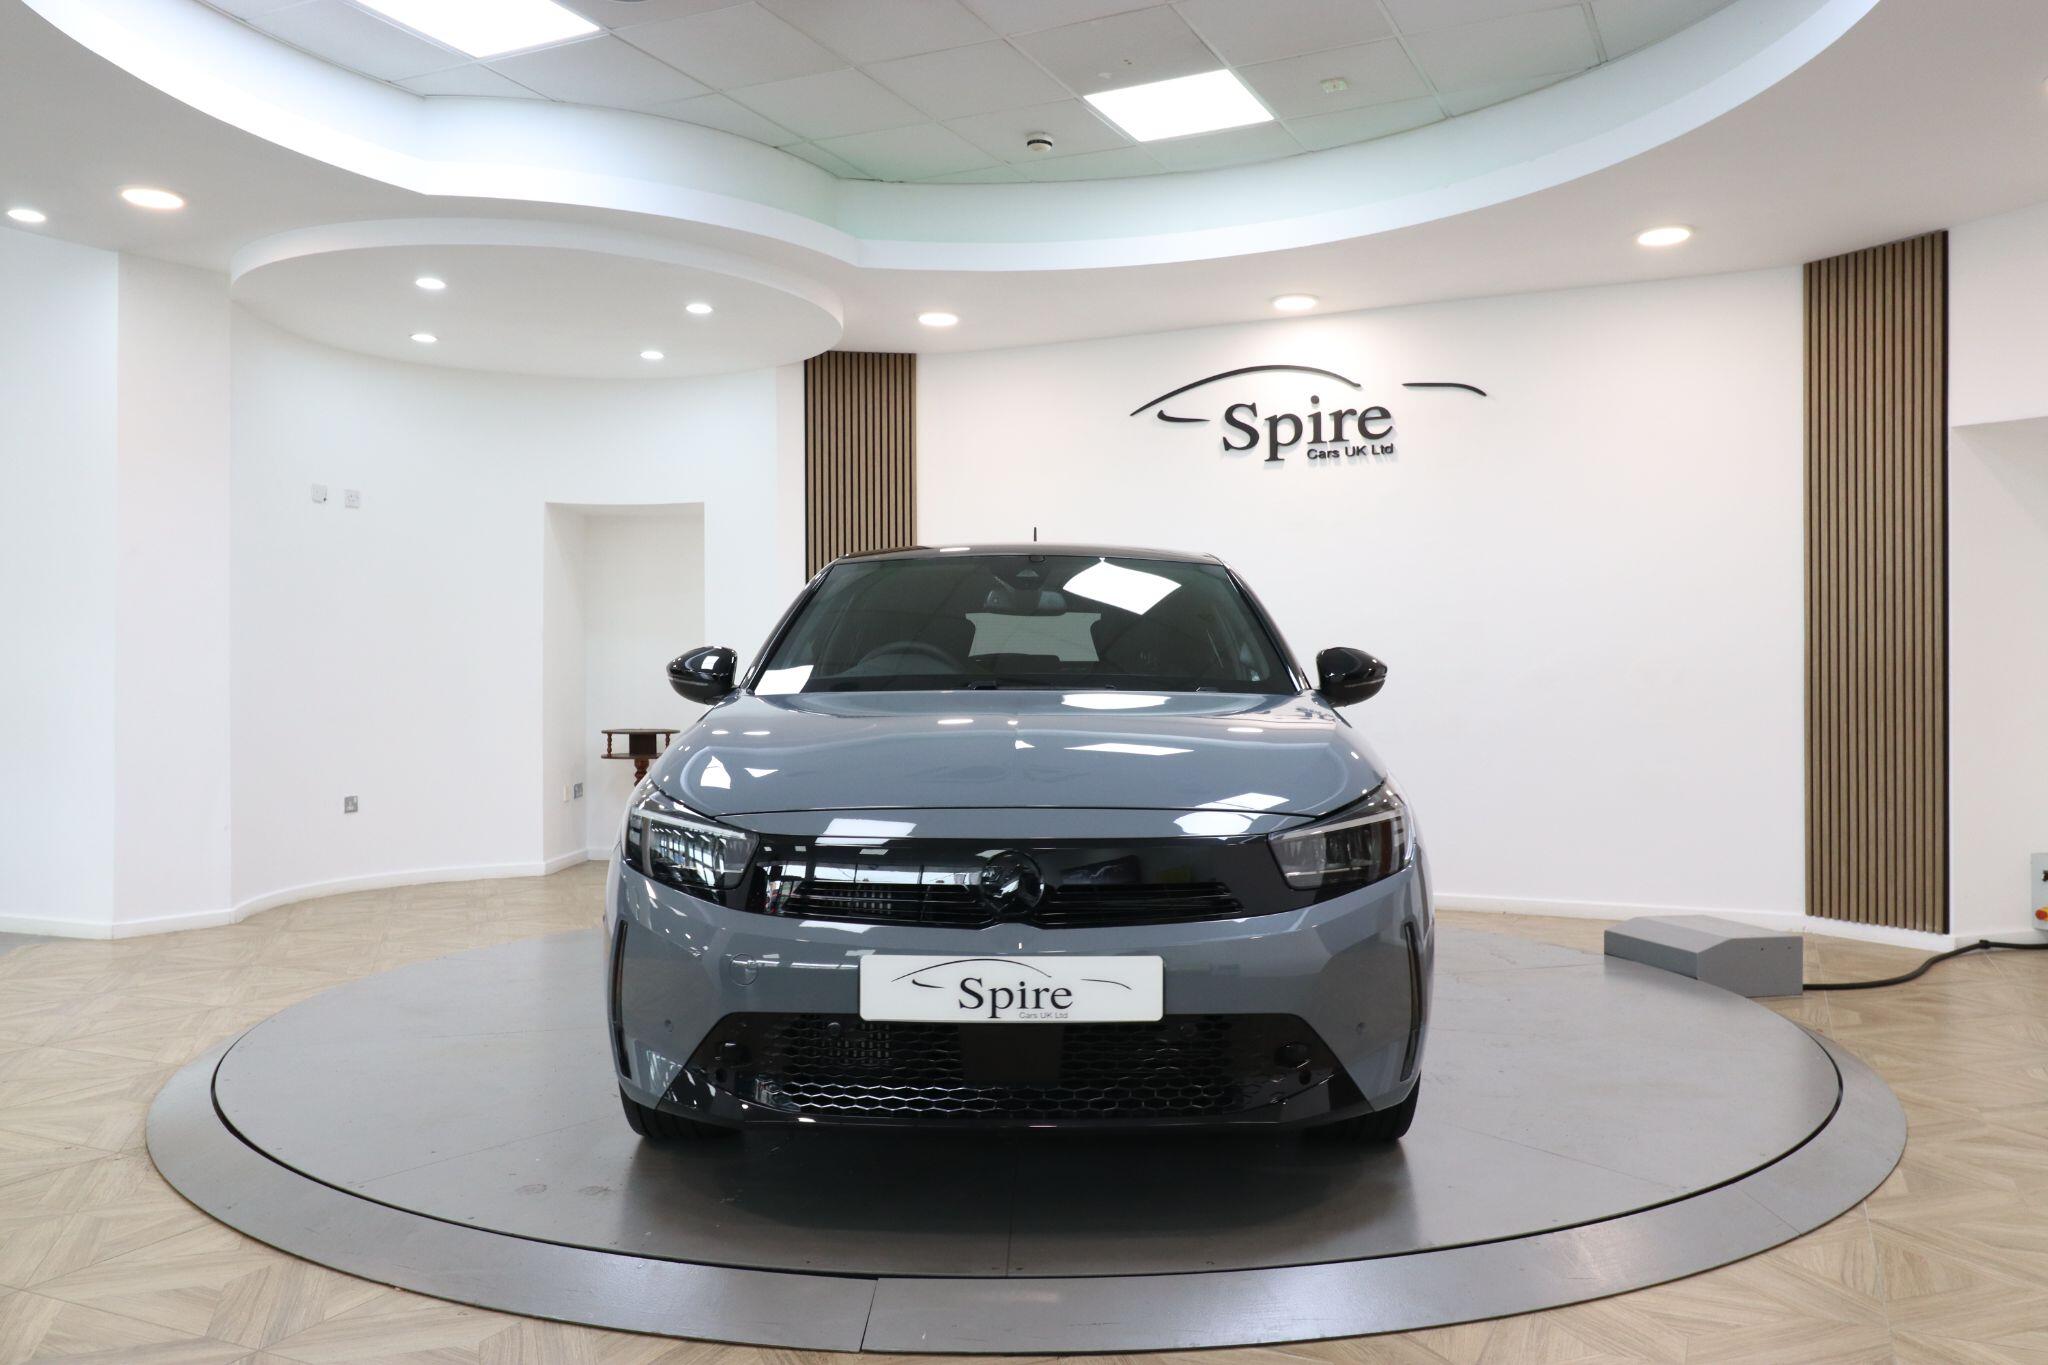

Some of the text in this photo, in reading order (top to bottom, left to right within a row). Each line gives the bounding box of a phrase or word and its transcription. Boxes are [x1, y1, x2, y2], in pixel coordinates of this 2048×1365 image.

[1222, 394, 1393, 462] Spire
[1306, 442, 1394, 460] Cars UK Ltd
[958, 977, 1073, 1018] Spire
[1018, 1011, 1038, 1019] Cars
